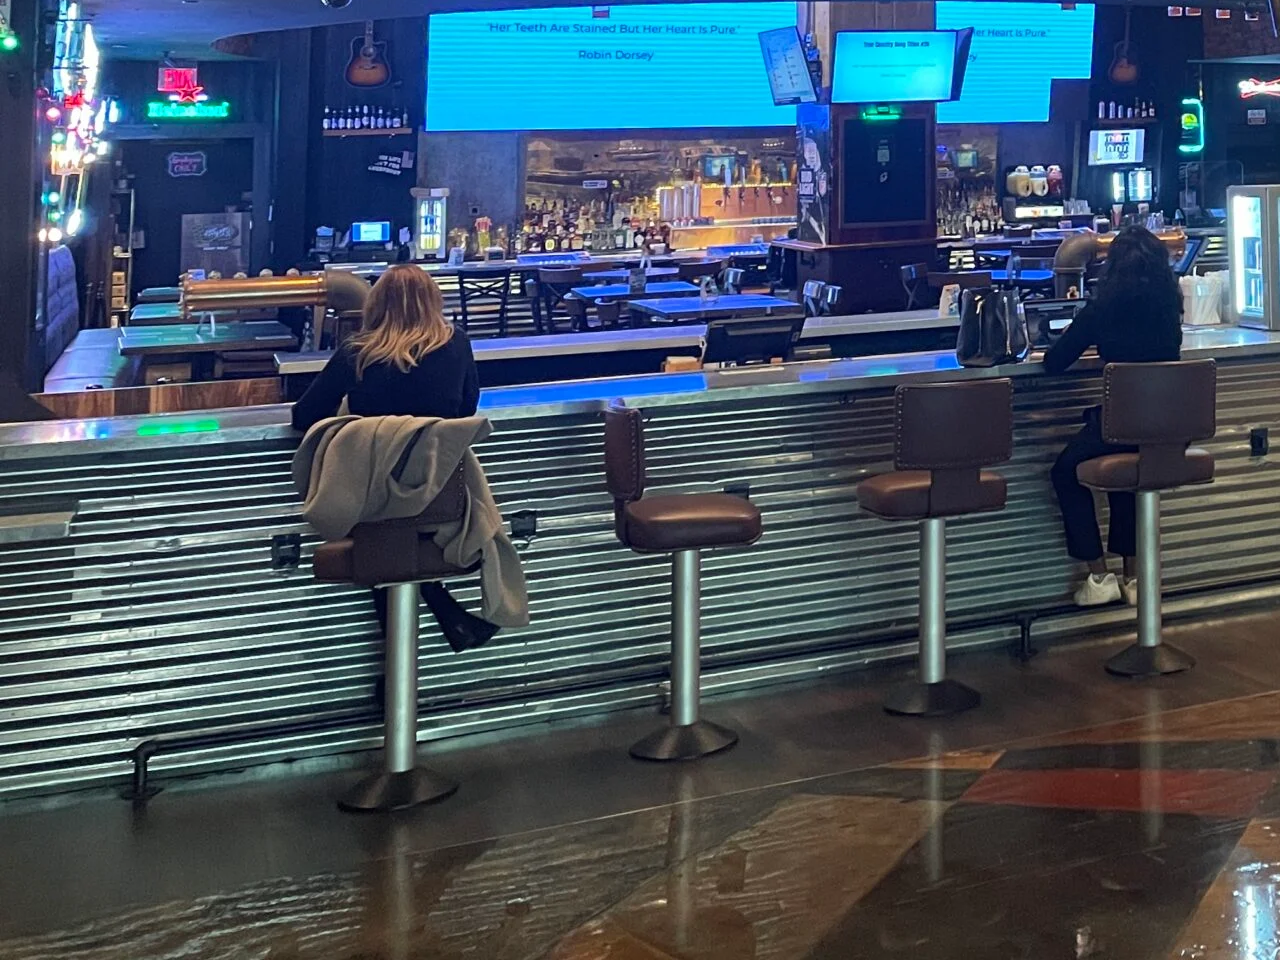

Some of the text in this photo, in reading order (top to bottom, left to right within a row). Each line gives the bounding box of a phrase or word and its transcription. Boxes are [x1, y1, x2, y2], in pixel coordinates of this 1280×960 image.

[514, 23, 547, 33] Teeth
[549, 23, 571, 34] Are
[573, 23, 617, 35] Stained
[619, 24, 641, 35] But
[642, 24, 663, 35] Her
[665, 24, 696, 35] Heart
[698, 25, 708, 35] Is
[987, 28, 1013, 38] Heart
[1015, 29, 1023, 38] Is
[578, 50, 655, 62] Robin Dorsey
